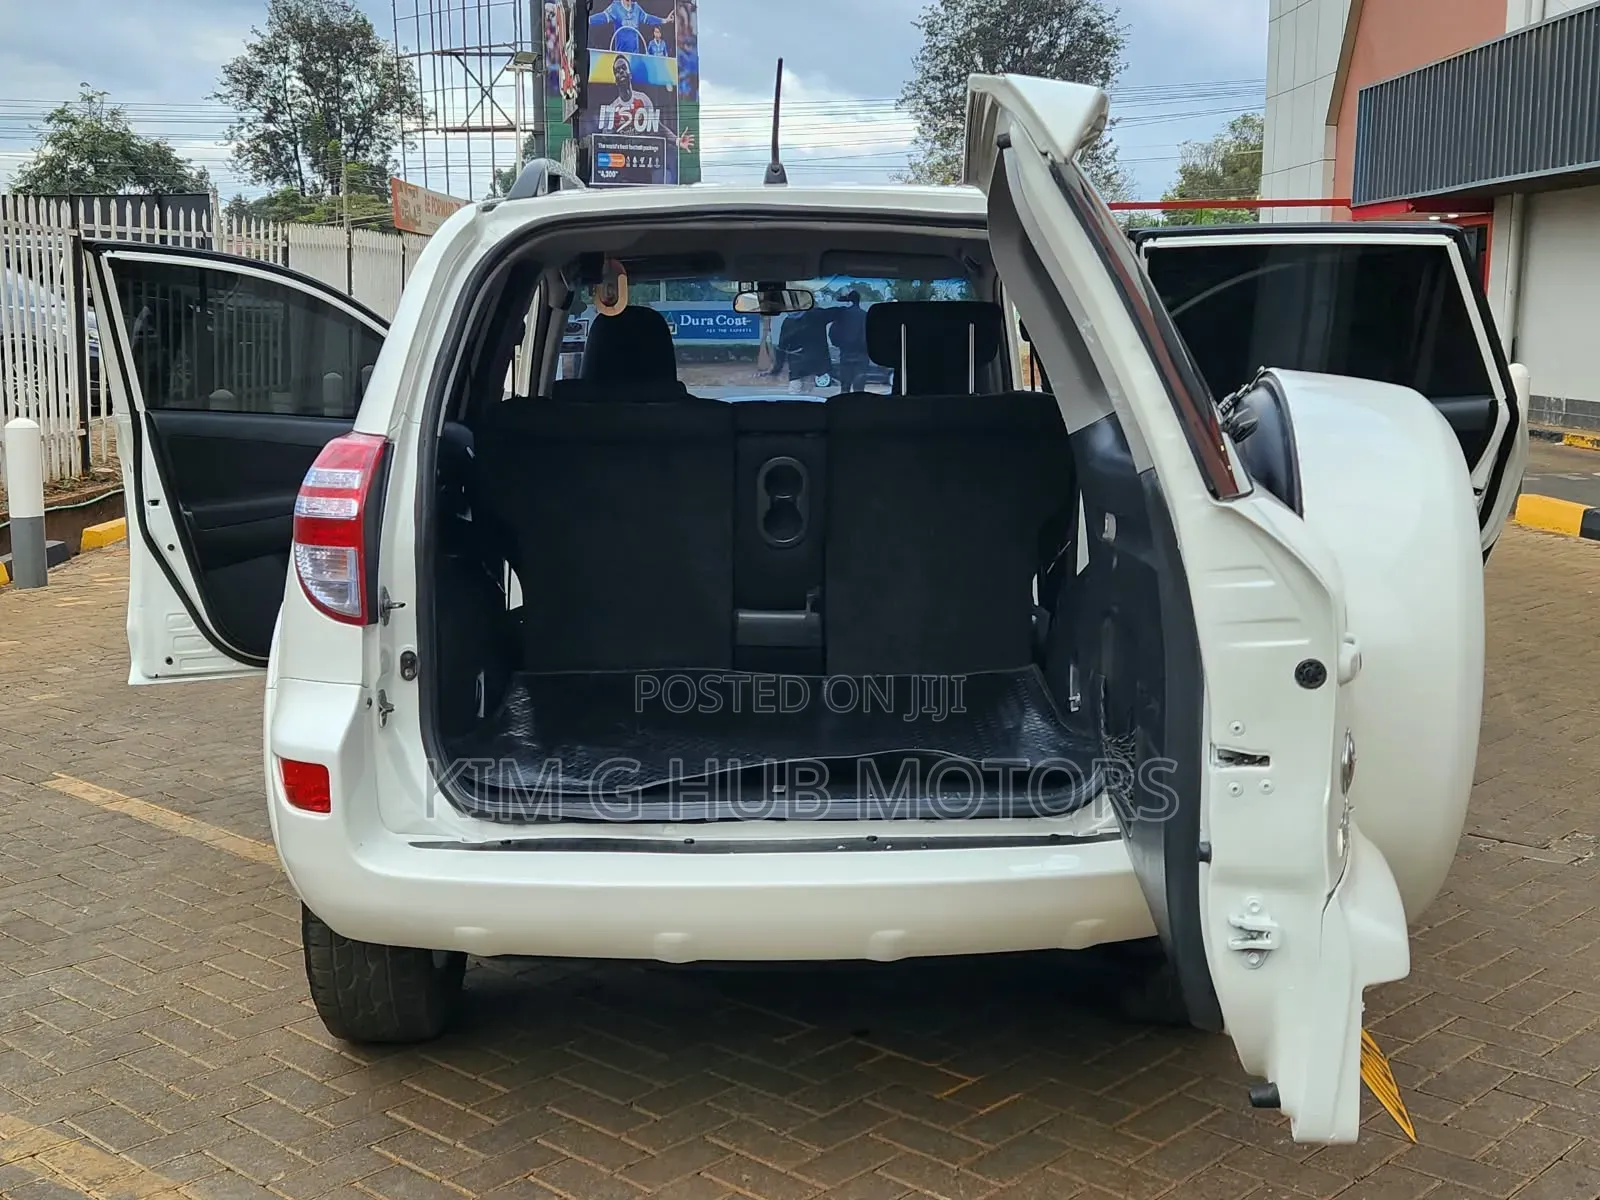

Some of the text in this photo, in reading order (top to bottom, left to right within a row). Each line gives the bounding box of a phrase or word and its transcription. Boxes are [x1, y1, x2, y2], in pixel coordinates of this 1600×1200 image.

[598, 104, 660, 133] IT'S ON
[680, 314, 752, 326] Dura Coat
